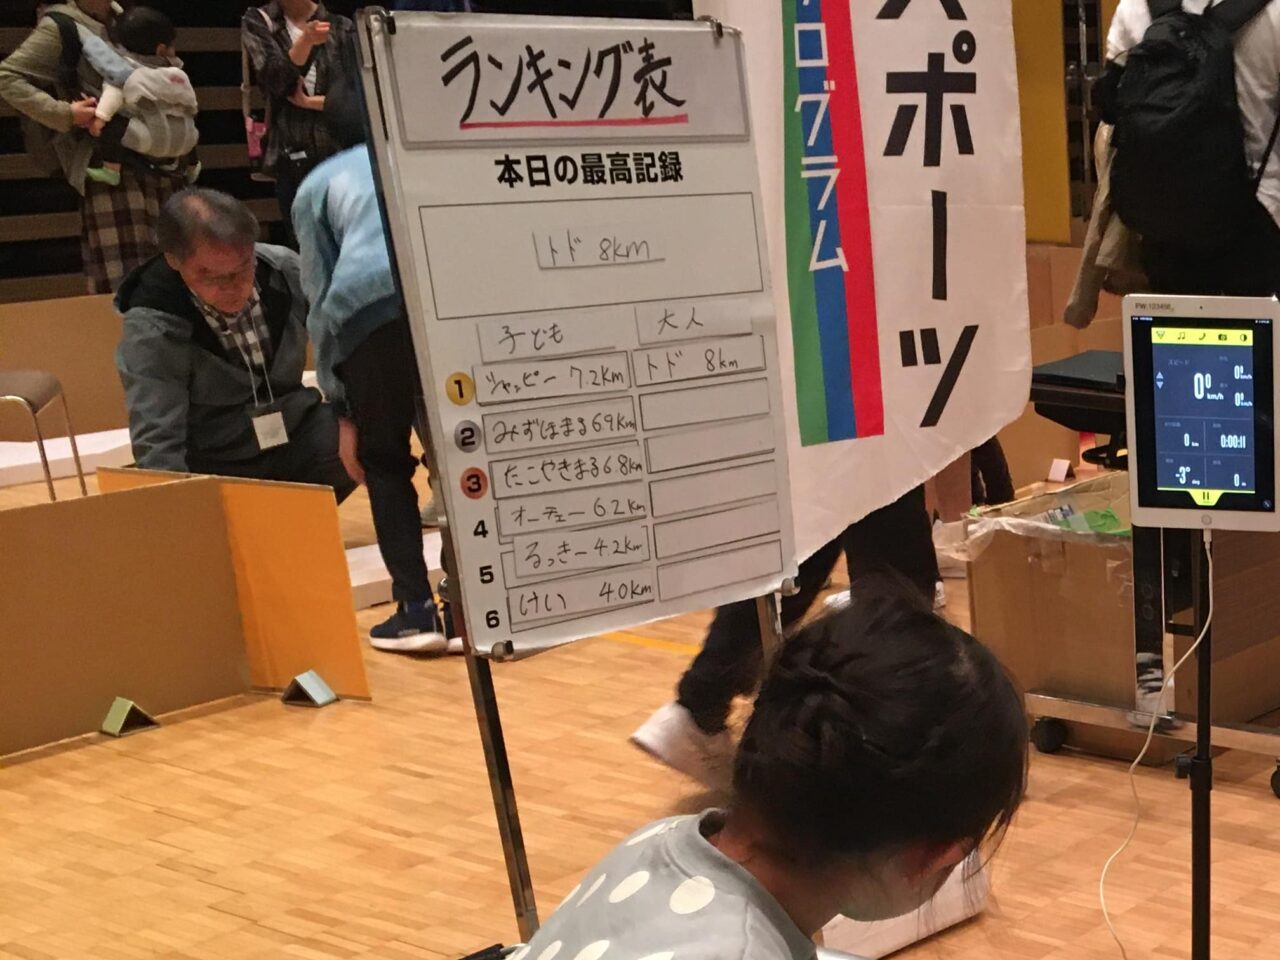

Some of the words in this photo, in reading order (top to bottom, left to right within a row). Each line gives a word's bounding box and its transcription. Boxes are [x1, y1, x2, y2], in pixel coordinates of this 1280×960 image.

[440, 35, 687, 123] ランキング表
[794, 0, 850, 272] ログラム
[494, 150, 684, 188] 本日の最高記録
[874, 0, 980, 428] ポーツ
[548, 229, 582, 266] トド
[599, 235, 650, 262] 8km
[658, 306, 703, 335] 大人
[498, 324, 563, 354] 子ども
[647, 350, 683, 380] トド
[704, 348, 738, 372] 8km
[453, 378, 465, 399] 1
[460, 428, 476, 447] 2
[466, 473, 482, 493] 3
[473, 520, 488, 539] 4
[479, 565, 494, 584] 5
[485, 609, 500, 628] 6
[519, 592, 566, 616] けい
